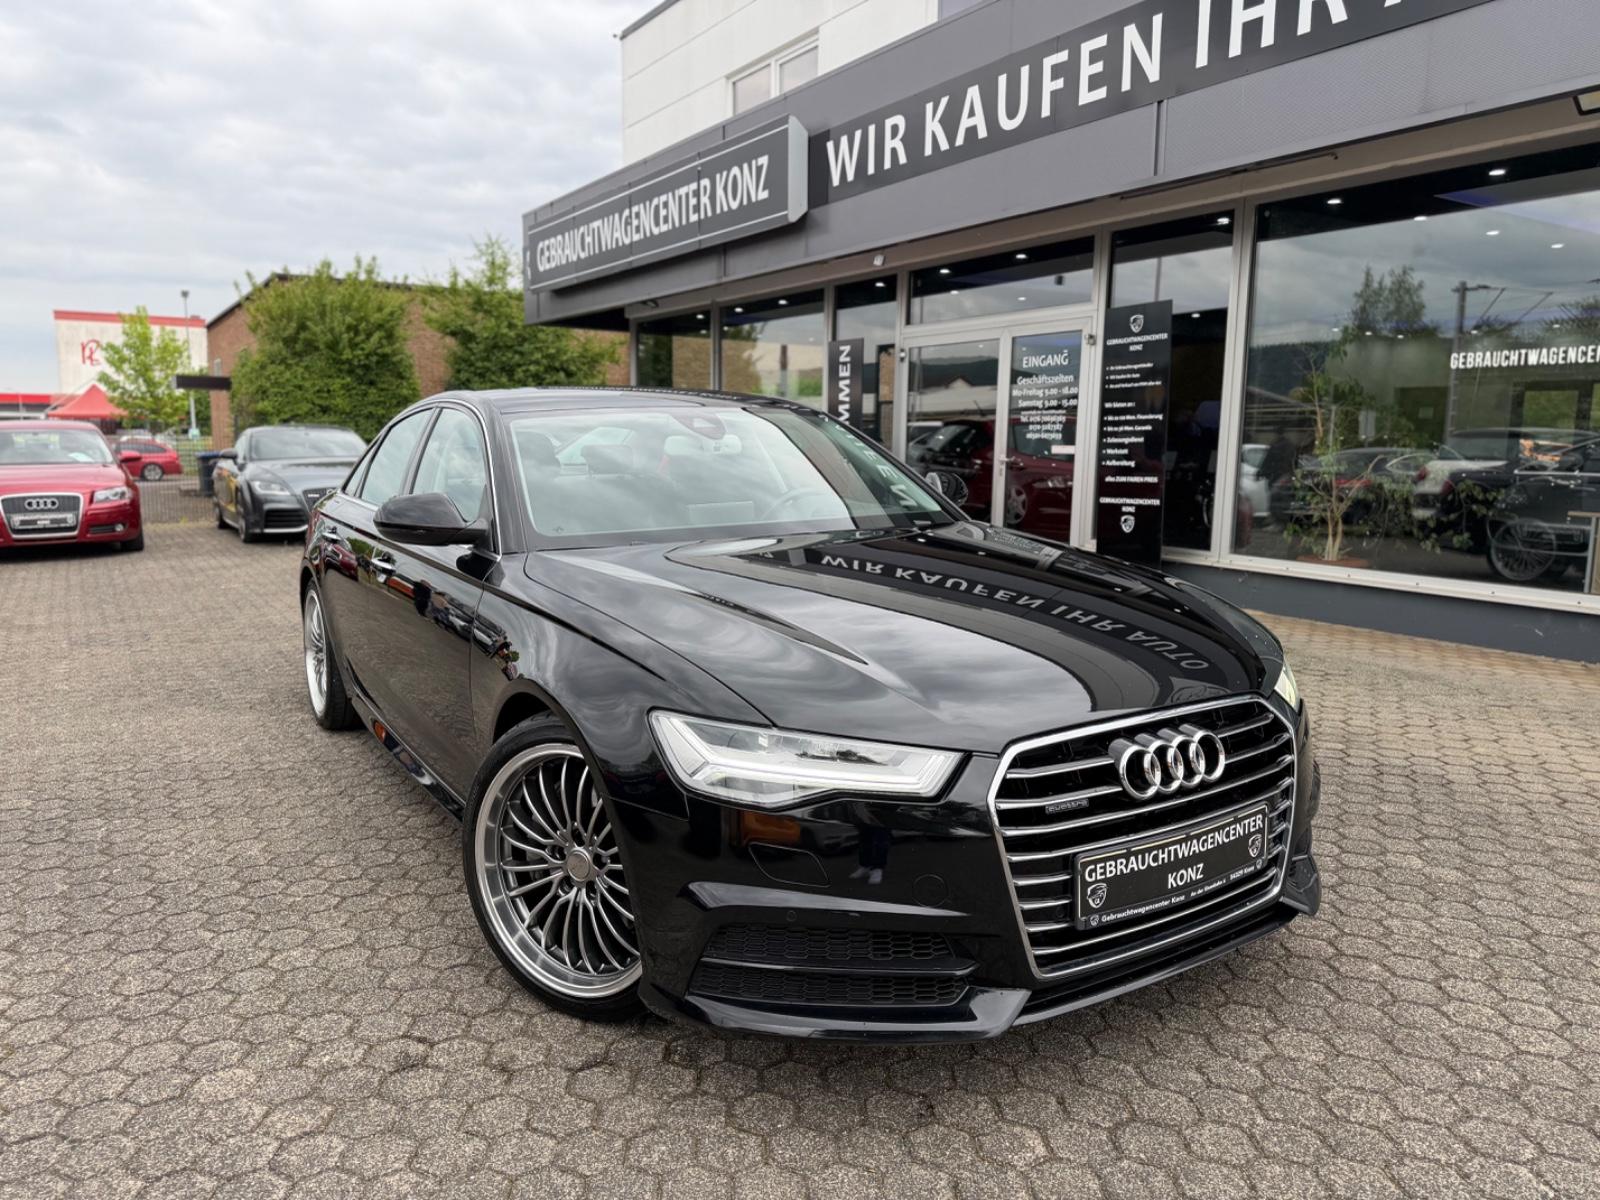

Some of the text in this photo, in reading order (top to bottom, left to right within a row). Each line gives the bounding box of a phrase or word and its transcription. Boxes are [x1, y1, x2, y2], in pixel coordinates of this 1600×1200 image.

[826, 113, 908, 188] WIR
[924, 13, 1164, 157] KAUFEN
[536, 155, 770, 273] GEBRAUCHTWAGENCENTER KONZ
[1022, 353, 1069, 369] EINGANG
[1016, 373, 1074, 385] Geschäftszeiten
[1085, 813, 1263, 882] GEBRAUCHTWAGENCENTER
[1167, 863, 1204, 889] KONZ
[1101, 898, 1170, 922] Gebrauchtwagencenter
[1171, 895, 1185, 904] Konz
